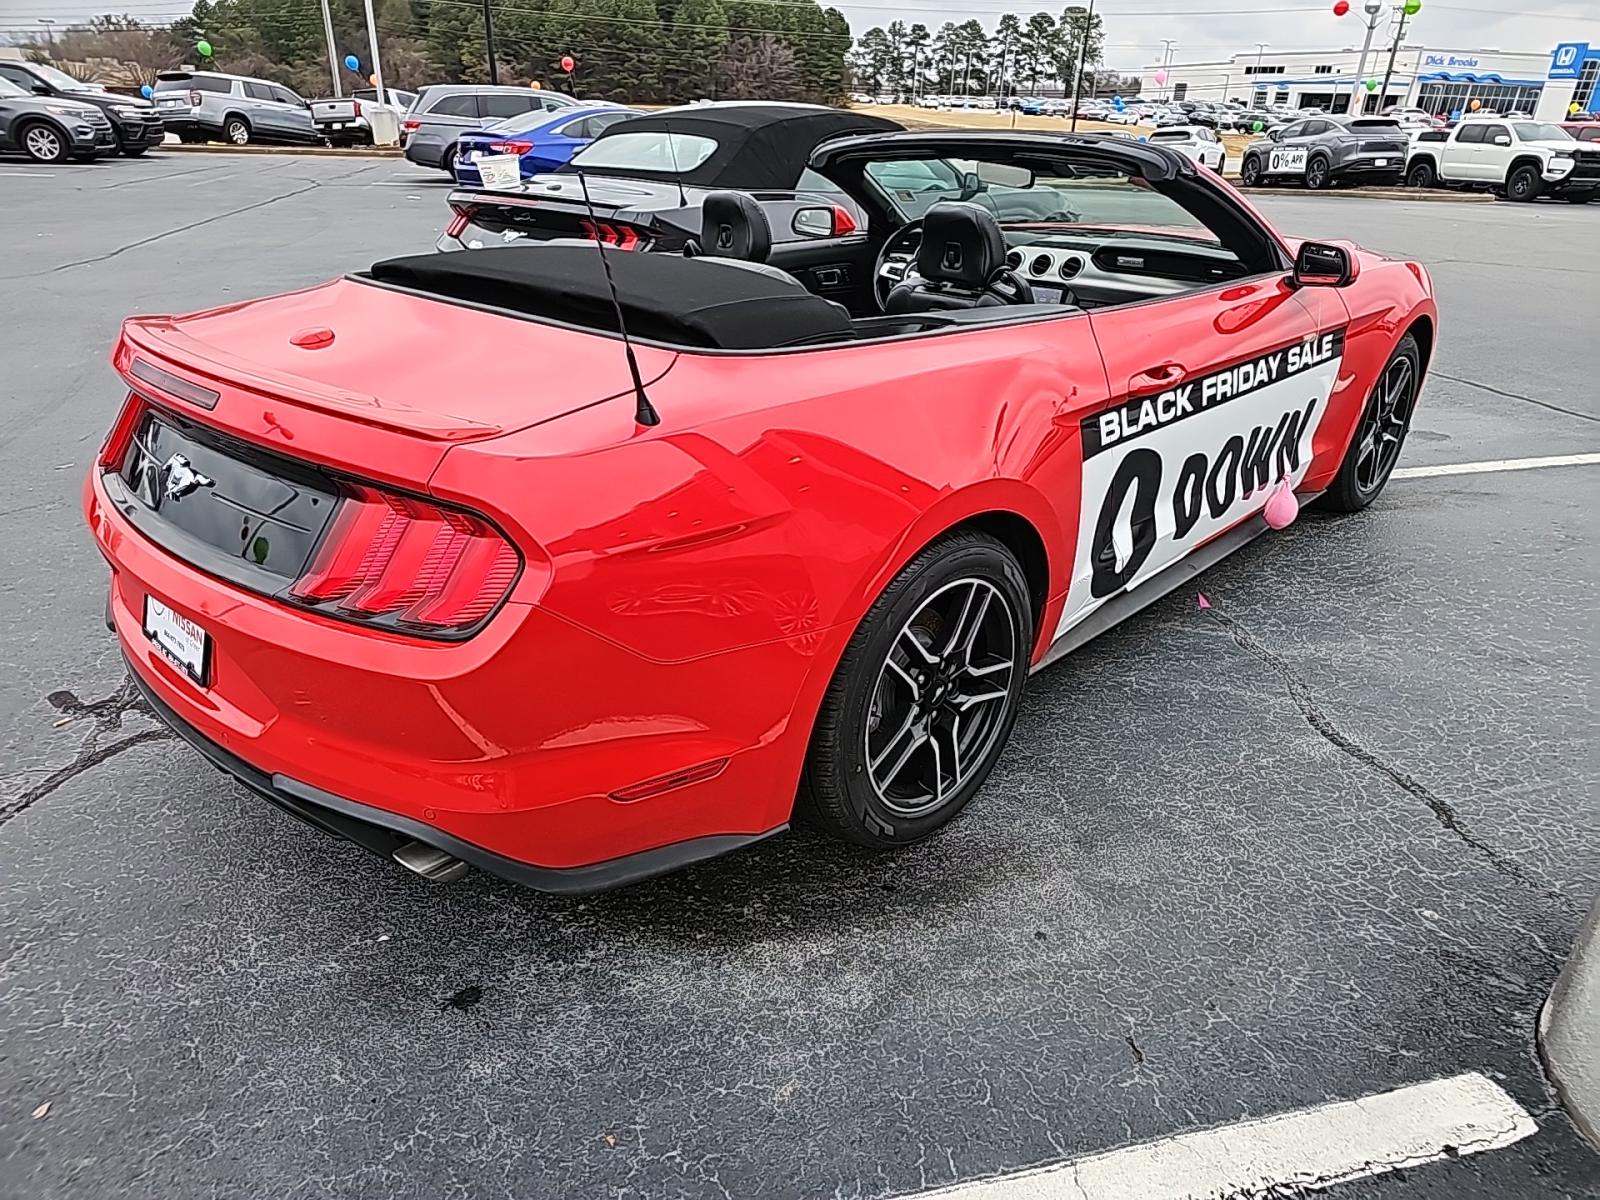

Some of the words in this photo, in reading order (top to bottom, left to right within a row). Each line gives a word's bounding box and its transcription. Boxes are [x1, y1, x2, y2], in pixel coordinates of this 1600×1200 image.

[1425, 55, 1444, 65] Dick
[1447, 56, 1478, 67] Brooks
[1272, 153, 1290, 170] 0%
[1290, 154, 1304, 165] APR
[1099, 389, 1194, 446] BLACK
[1202, 353, 1282, 407] FRIDAY
[1287, 333, 1334, 373] SALE
[1091, 448, 1162, 599] 0
[1172, 397, 1318, 540] DOWN
[172, 611, 203, 645] NISSAN
